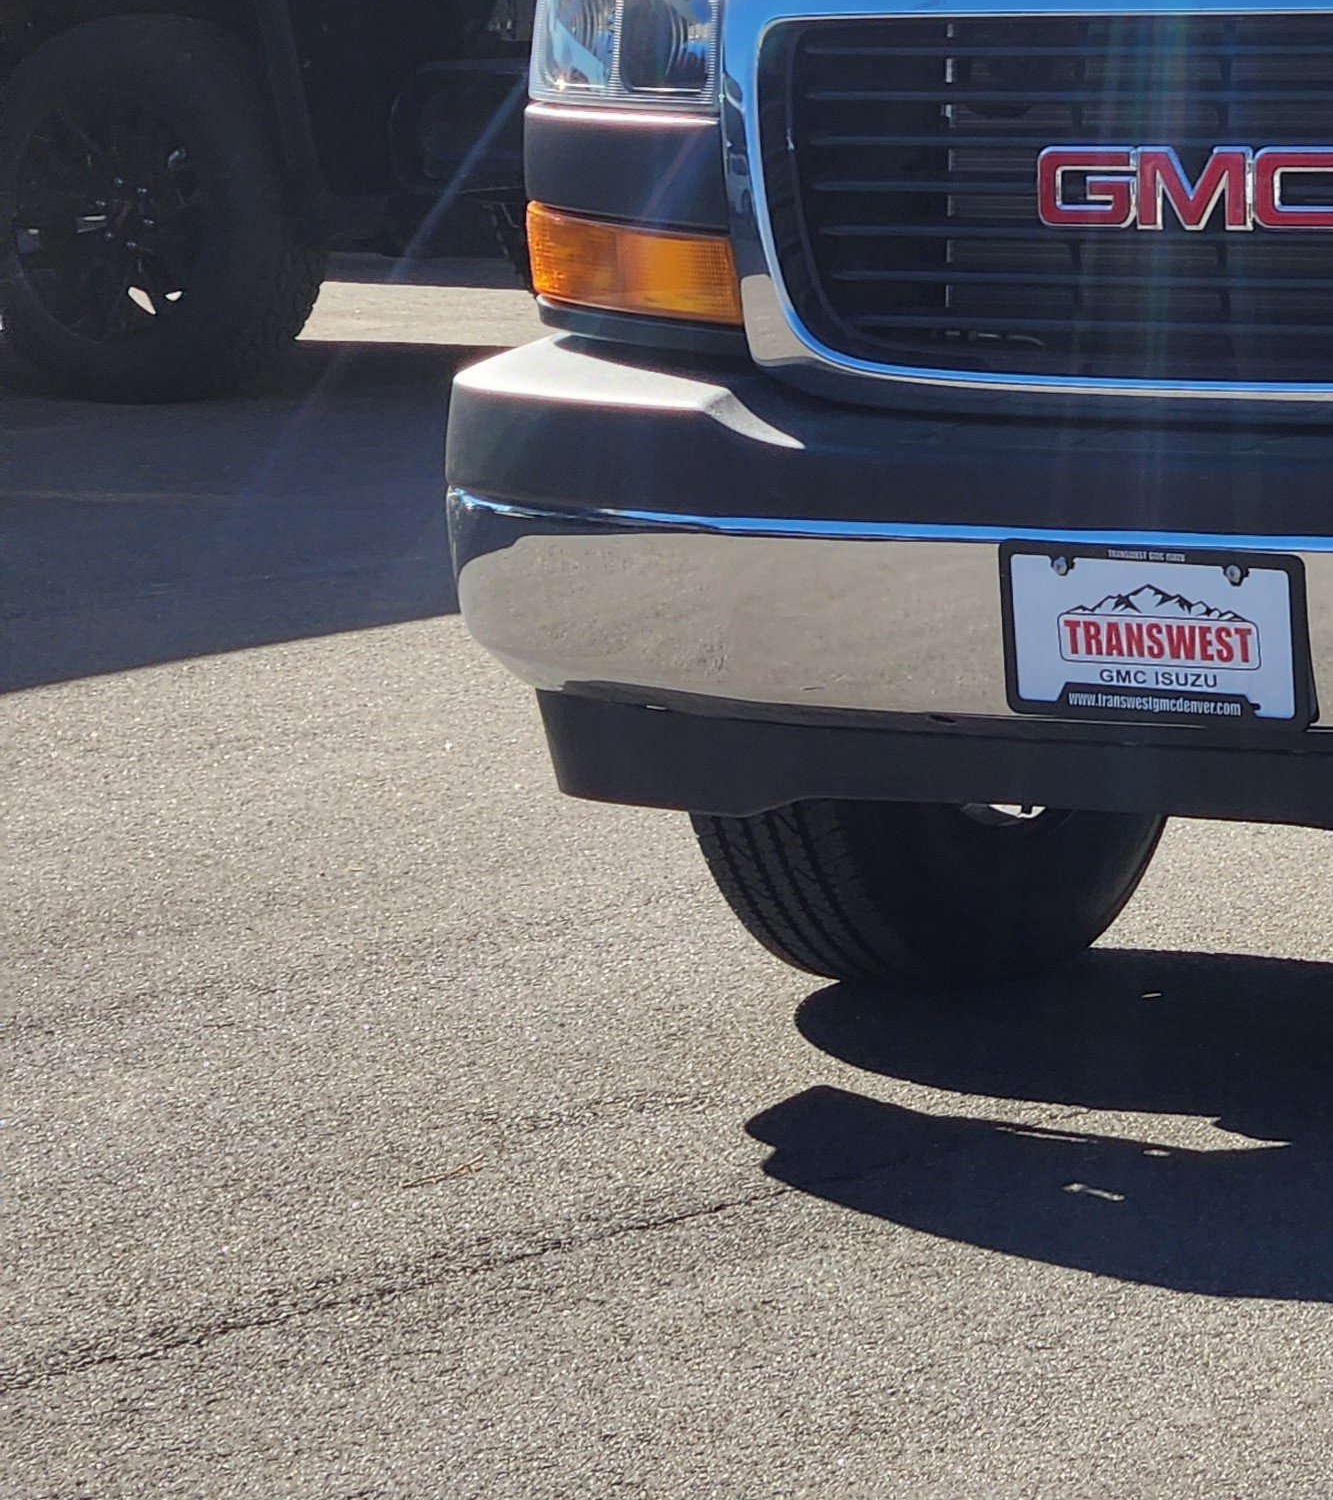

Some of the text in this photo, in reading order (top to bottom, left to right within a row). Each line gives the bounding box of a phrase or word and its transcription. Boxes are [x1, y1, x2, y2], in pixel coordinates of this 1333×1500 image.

[1063, 619, 1253, 664] TRANSWEST
[1099, 668, 1218, 689] GMC ISUZU
[1068, 691, 1242, 717] www.transwestgmcdenver.com
